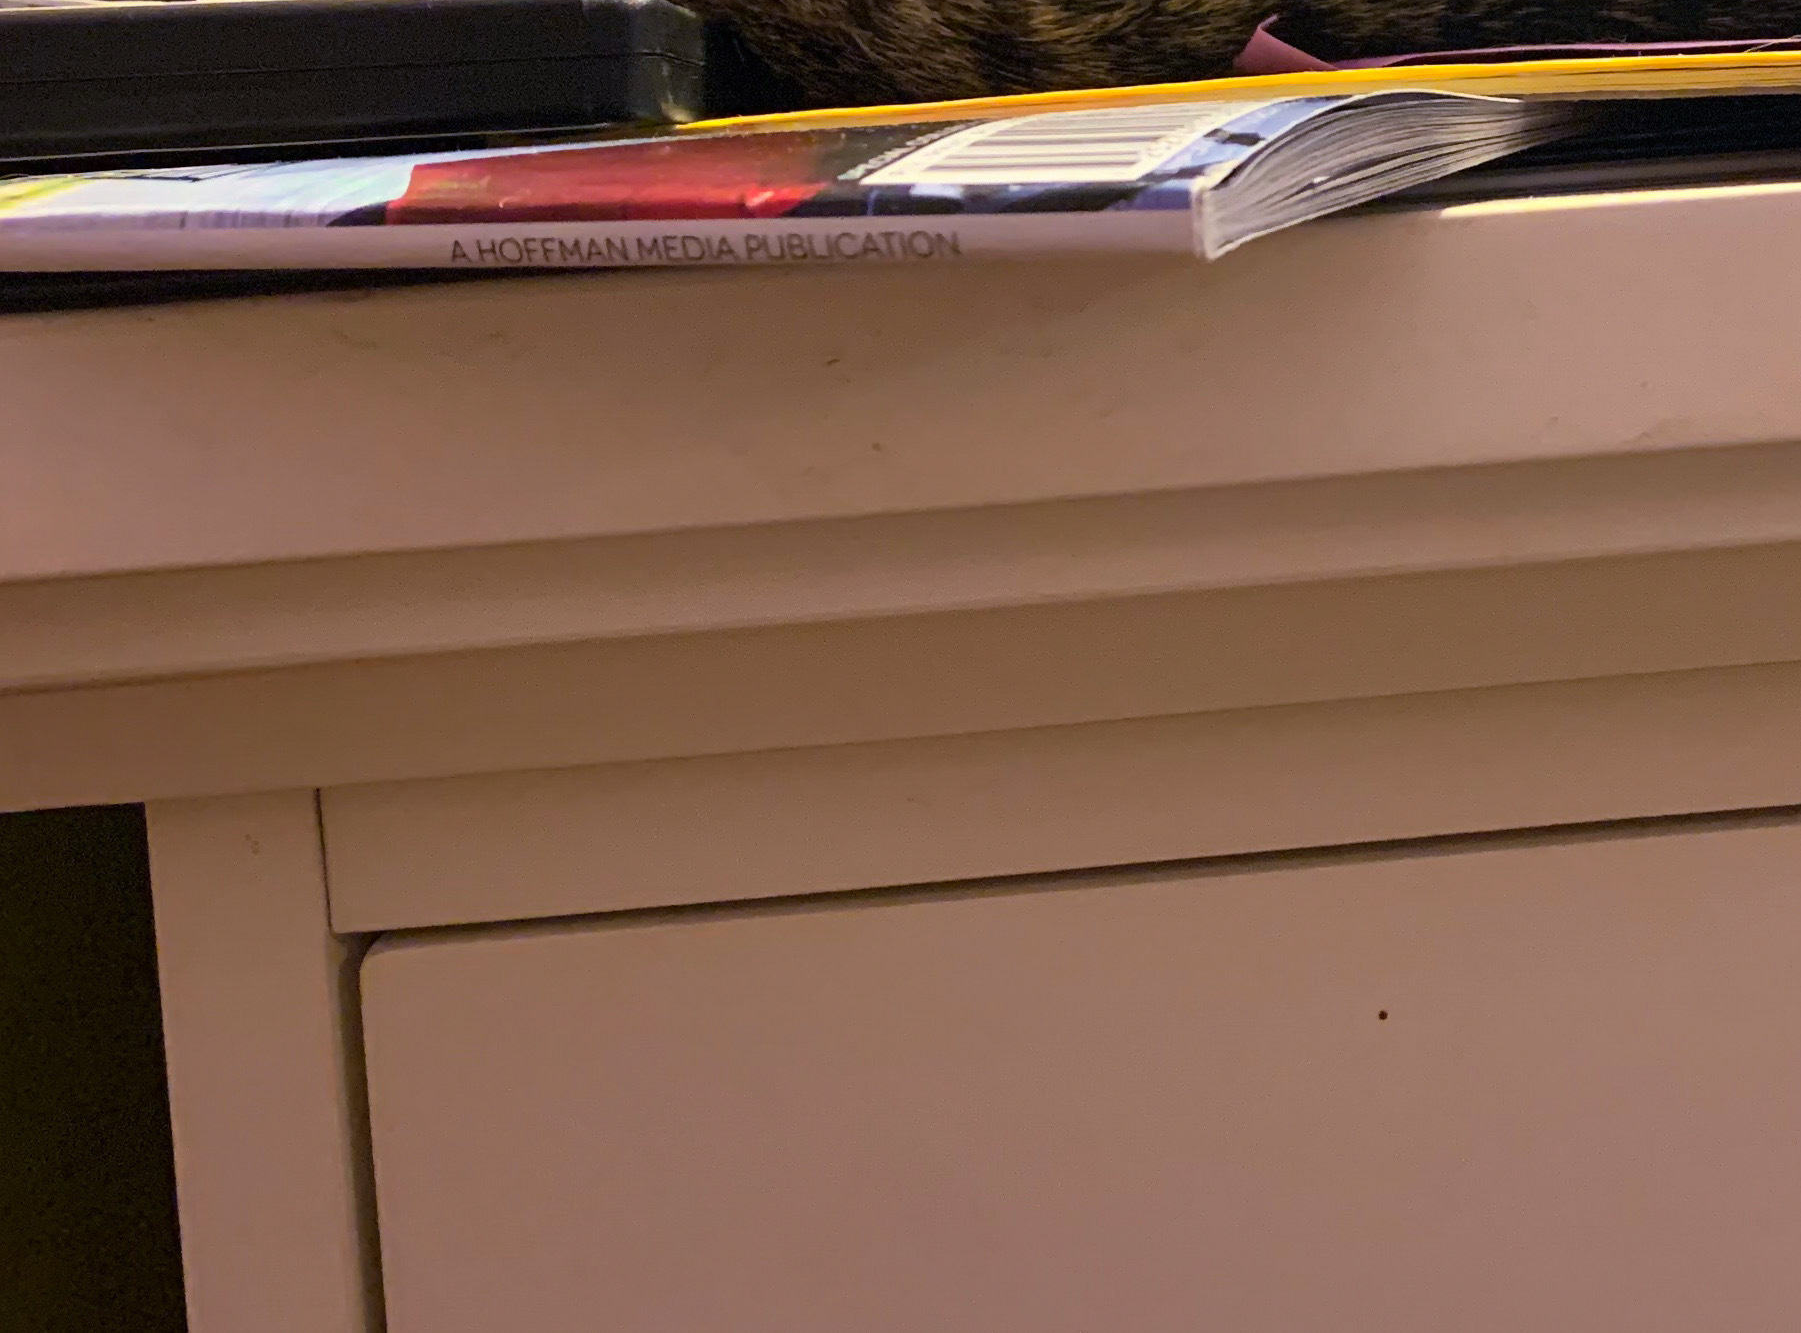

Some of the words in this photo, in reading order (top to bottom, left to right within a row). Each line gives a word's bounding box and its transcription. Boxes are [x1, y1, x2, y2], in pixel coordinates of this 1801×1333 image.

[452, 239, 471, 262] A
[476, 236, 629, 263] HOFFMAN
[635, 235, 739, 261] MEDIA
[744, 231, 961, 261] PUBLICATION
